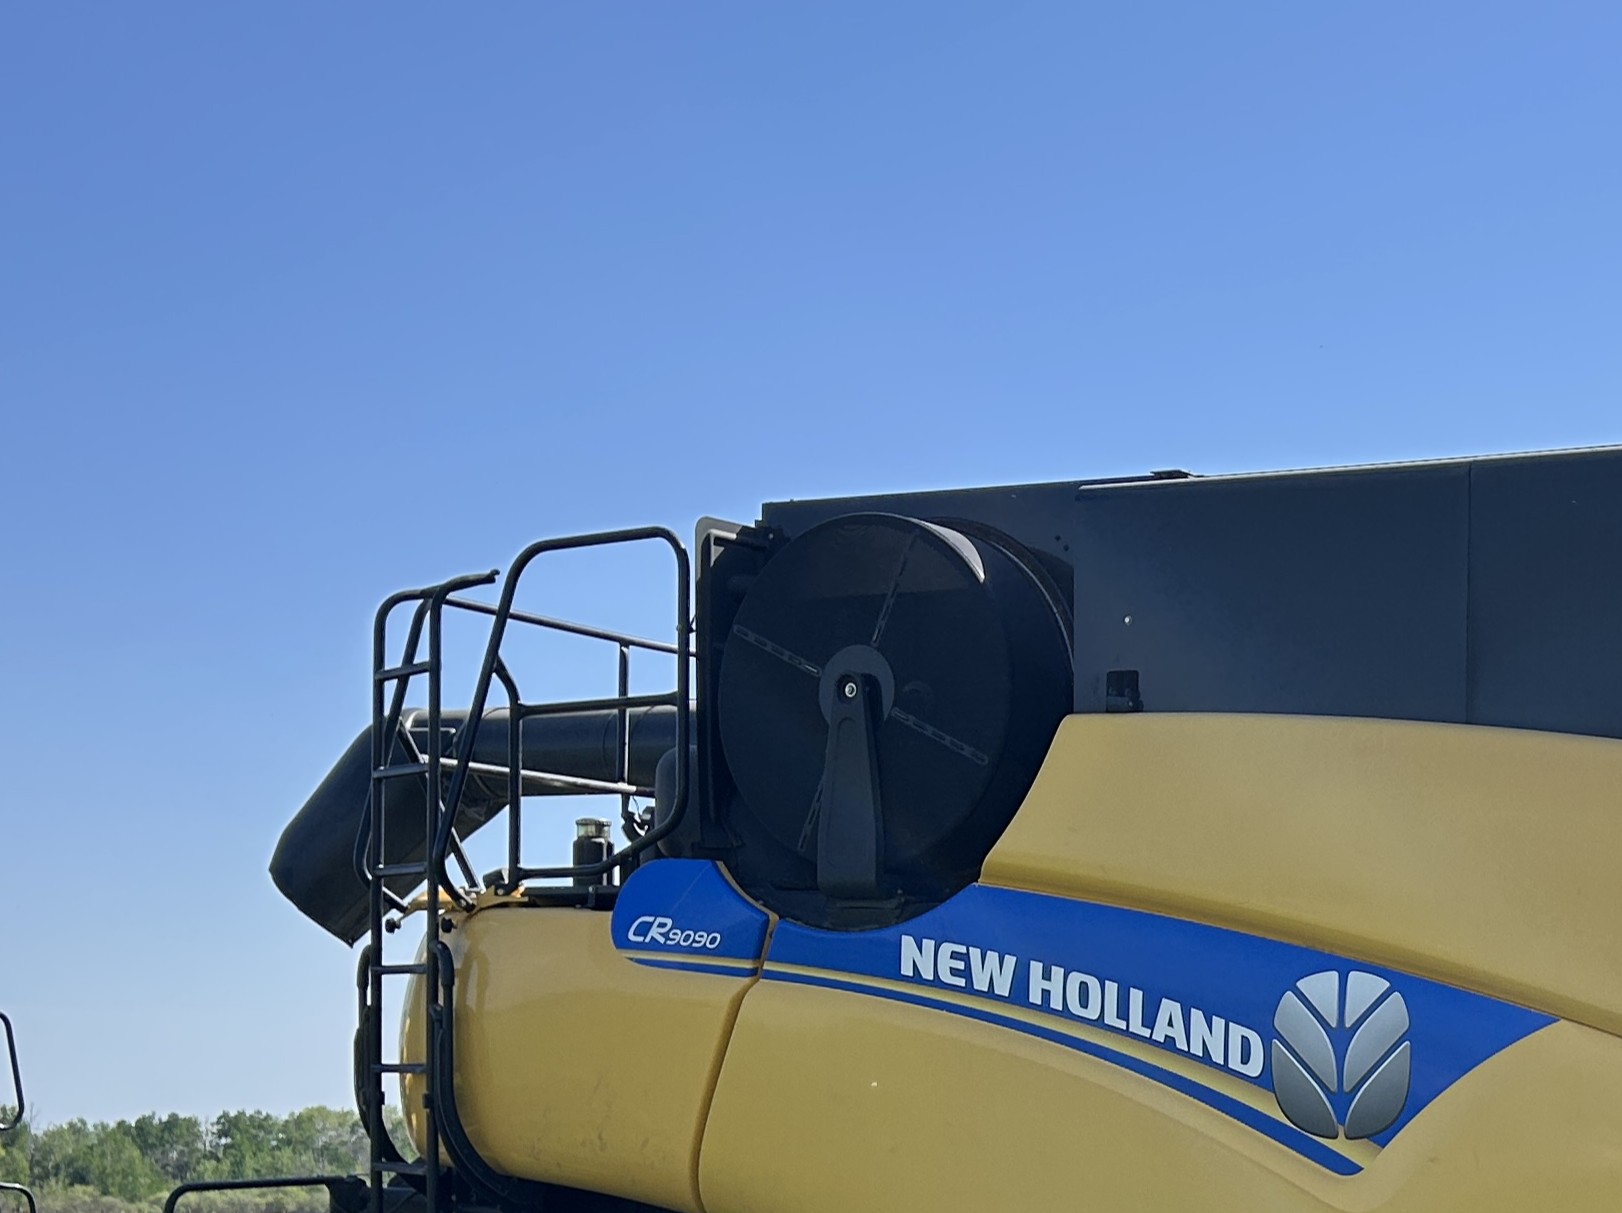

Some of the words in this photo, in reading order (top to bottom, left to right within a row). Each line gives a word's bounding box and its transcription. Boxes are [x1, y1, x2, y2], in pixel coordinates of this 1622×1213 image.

[627, 915, 721, 949] CR9090
[900, 934, 1017, 998] NEW
[1028, 959, 1265, 1078] HOLLAND
